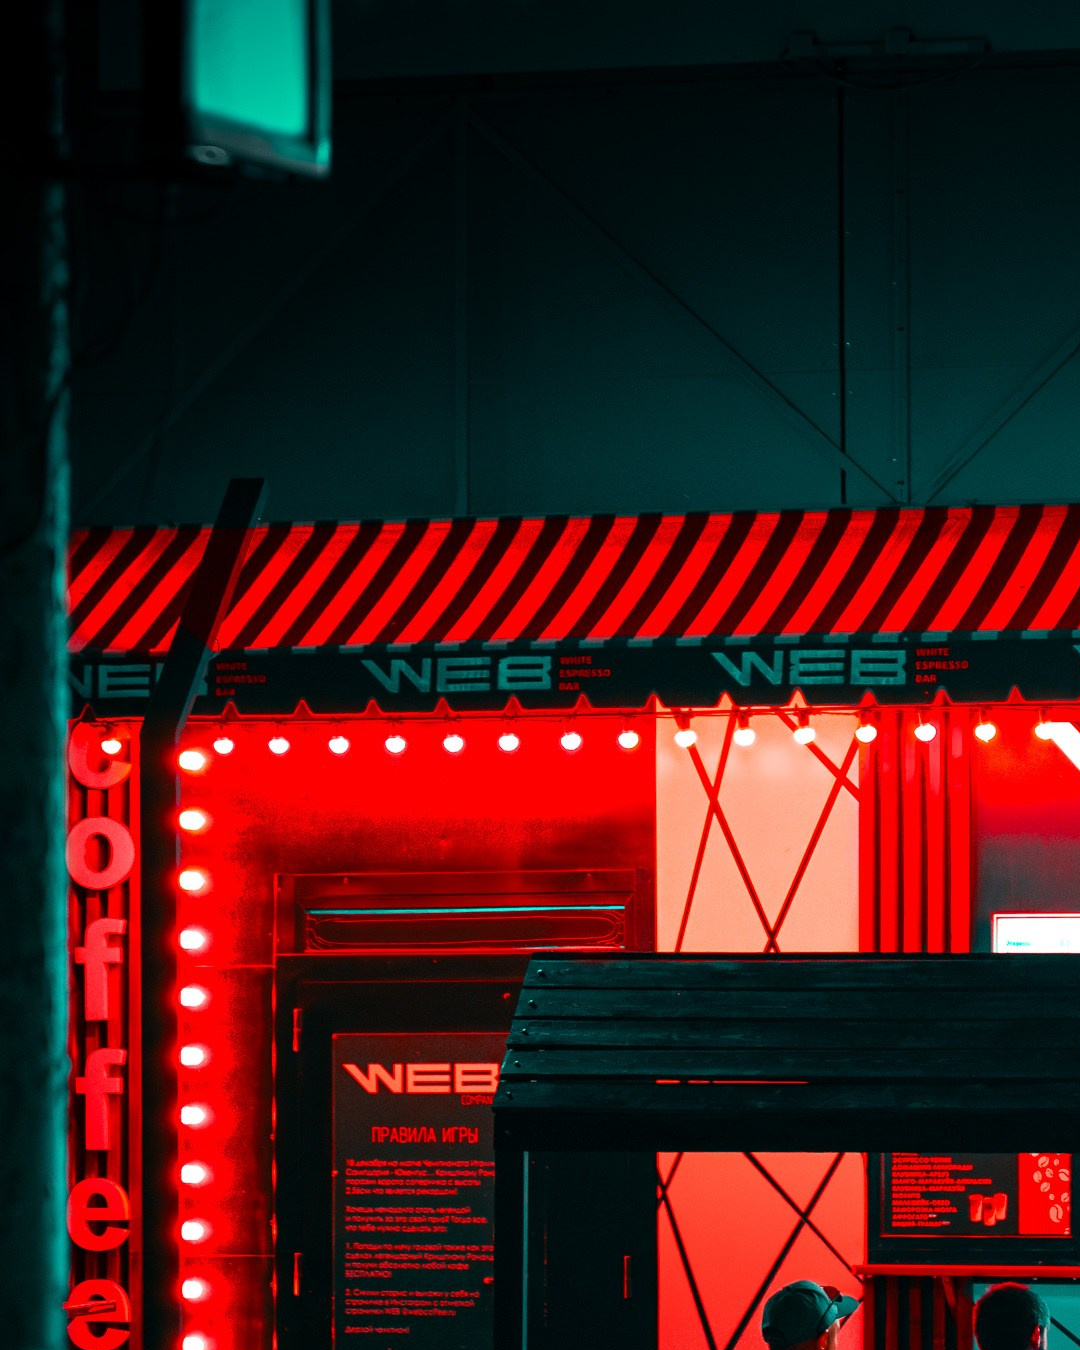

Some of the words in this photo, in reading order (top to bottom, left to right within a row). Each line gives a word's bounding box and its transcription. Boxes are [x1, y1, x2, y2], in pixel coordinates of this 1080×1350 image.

[916, 648, 949, 657] WHITE
[559, 656, 592, 665] WHITE
[915, 660, 969, 670] ESPRESSO
[710, 649, 907, 687] WEB
[360, 655, 552, 693] WEB
[559, 668, 611, 679] ESPRESSO
[915, 674, 937, 683] BAR
[558, 682, 580, 691] BAR
[341, 1063, 500, 1095] WEB
[371, 1126, 437, 1144] ПРАВИЛА
[441, 1126, 479, 1144] ИГРЫ
